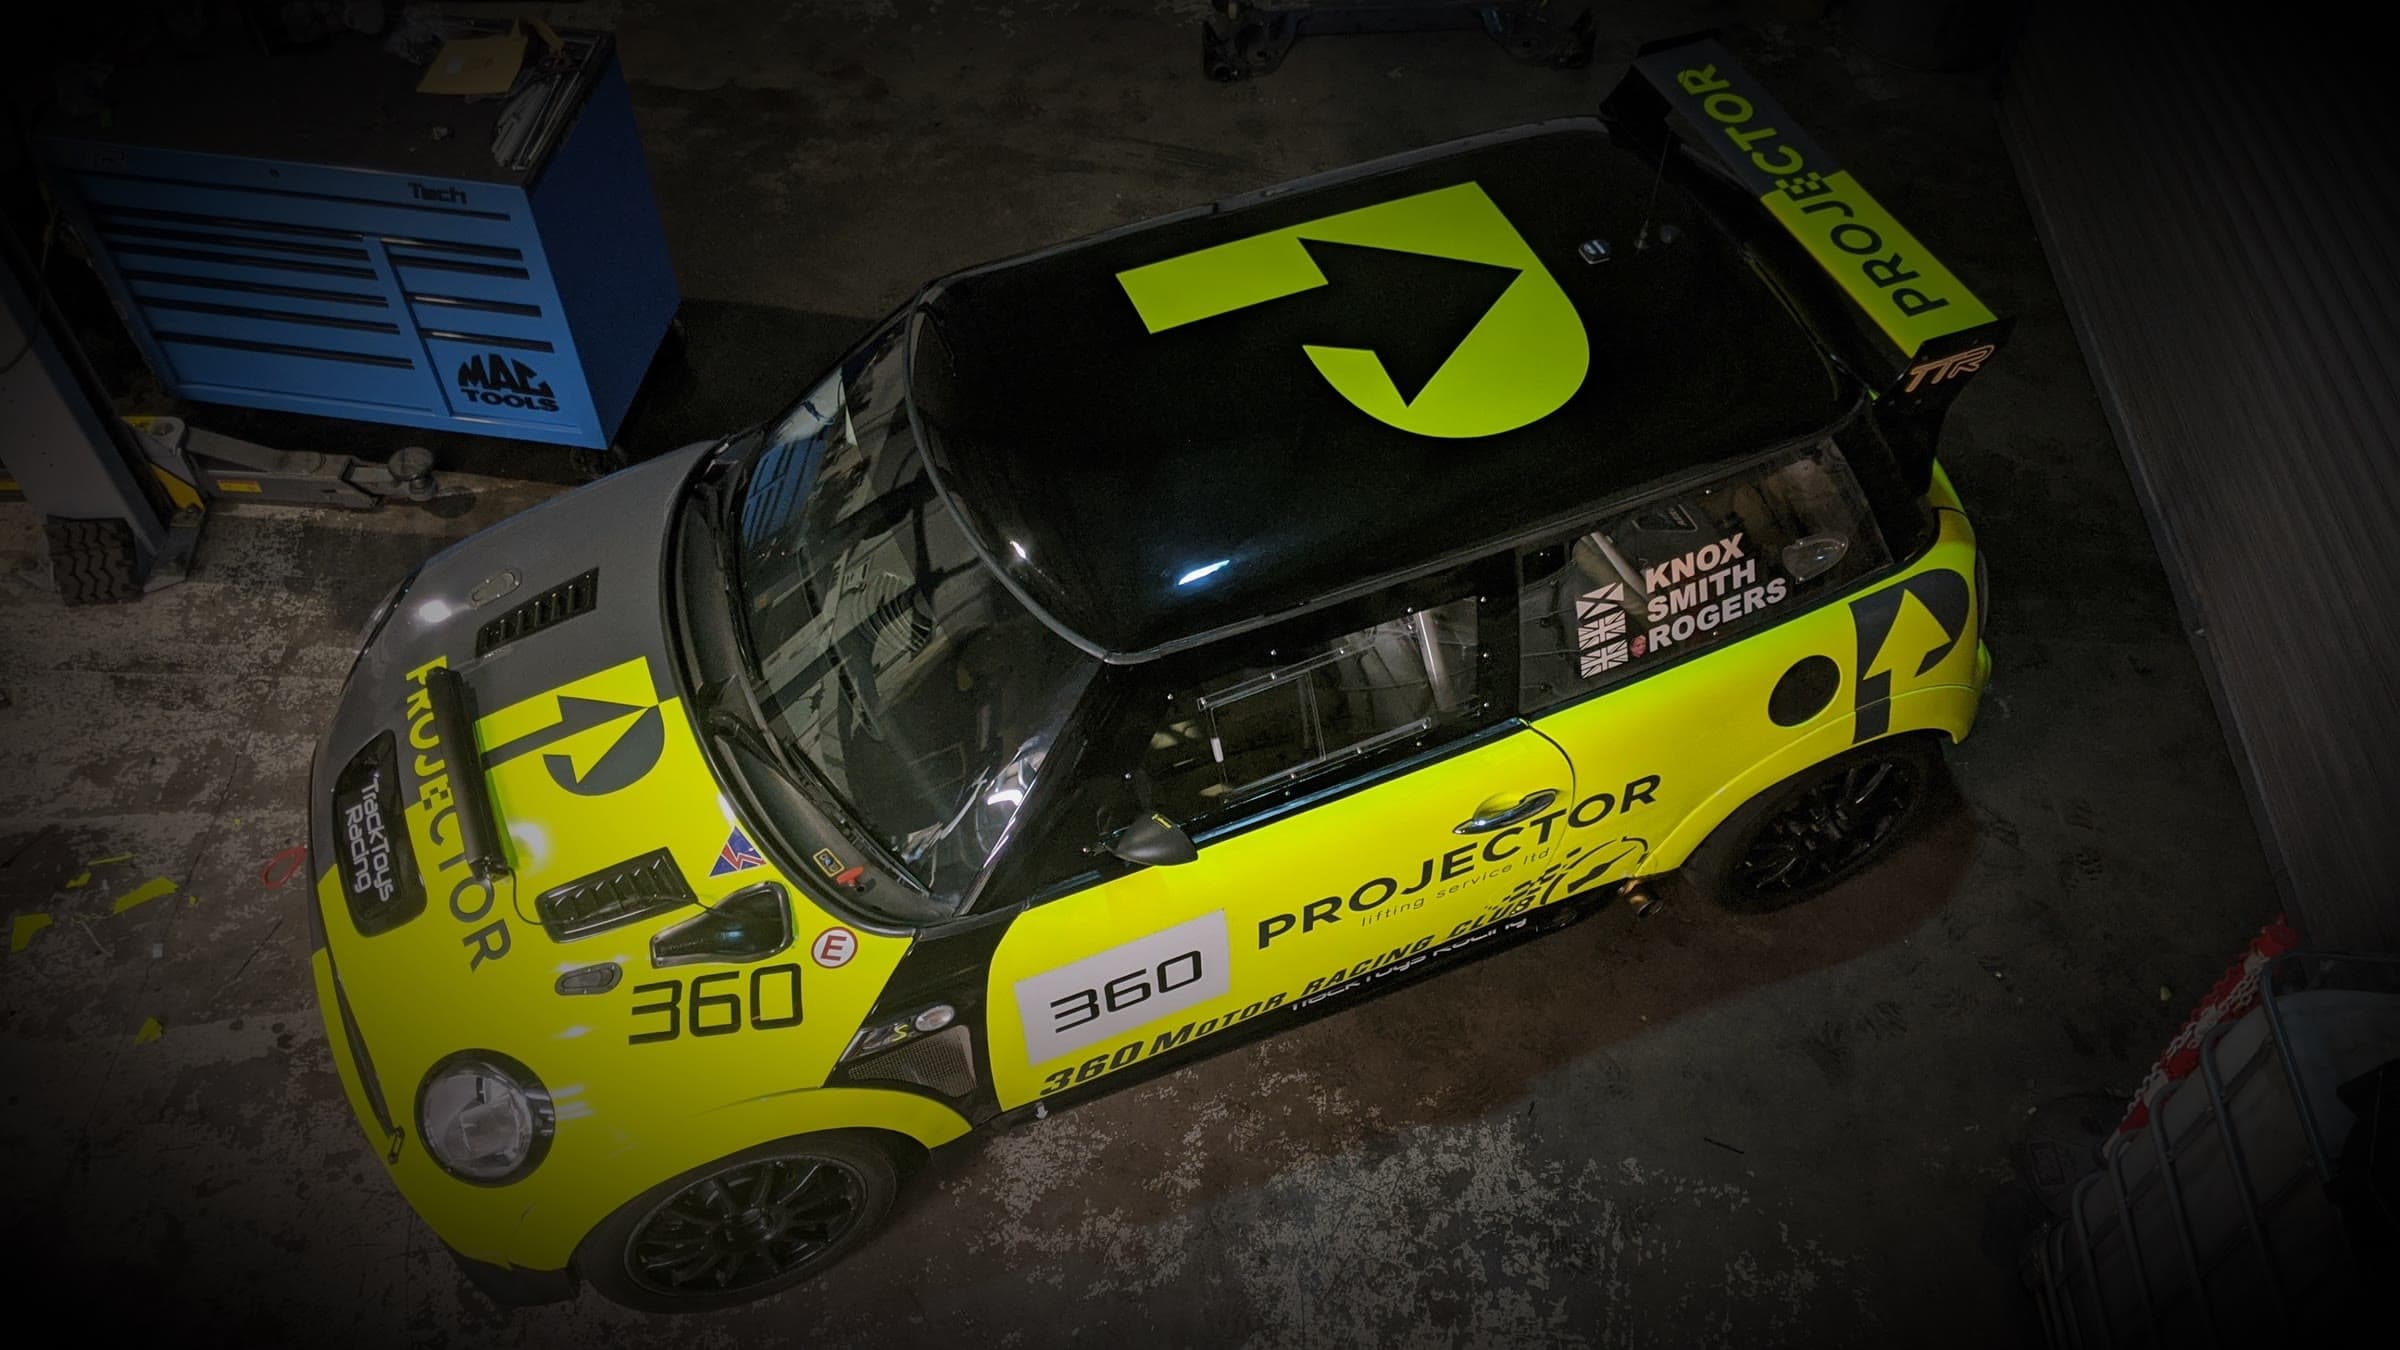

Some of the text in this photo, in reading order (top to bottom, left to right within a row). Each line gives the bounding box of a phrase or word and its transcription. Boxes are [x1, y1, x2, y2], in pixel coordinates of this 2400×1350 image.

[408, 181, 468, 204] Tech
[1676, 63, 1951, 318] PROJECTOR
[458, 354, 555, 398] MAC
[461, 389, 559, 412] TOOLS
[1904, 344, 1996, 393] TTR
[1645, 532, 1745, 594] KNOX
[1648, 558, 1756, 623] SMITH
[1648, 577, 1787, 653] ROGERS
[345, 803, 373, 893] Racing
[1257, 774, 1661, 949] PROJECTOR
[1361, 847, 1551, 927] lifting service ltd
[628, 963, 804, 1046] 360
[1040, 1041, 1145, 1097] 360
[1301, 935, 1436, 997] RACING
[1449, 894, 1537, 938] CLUB
[1050, 950, 1203, 1034] 360
